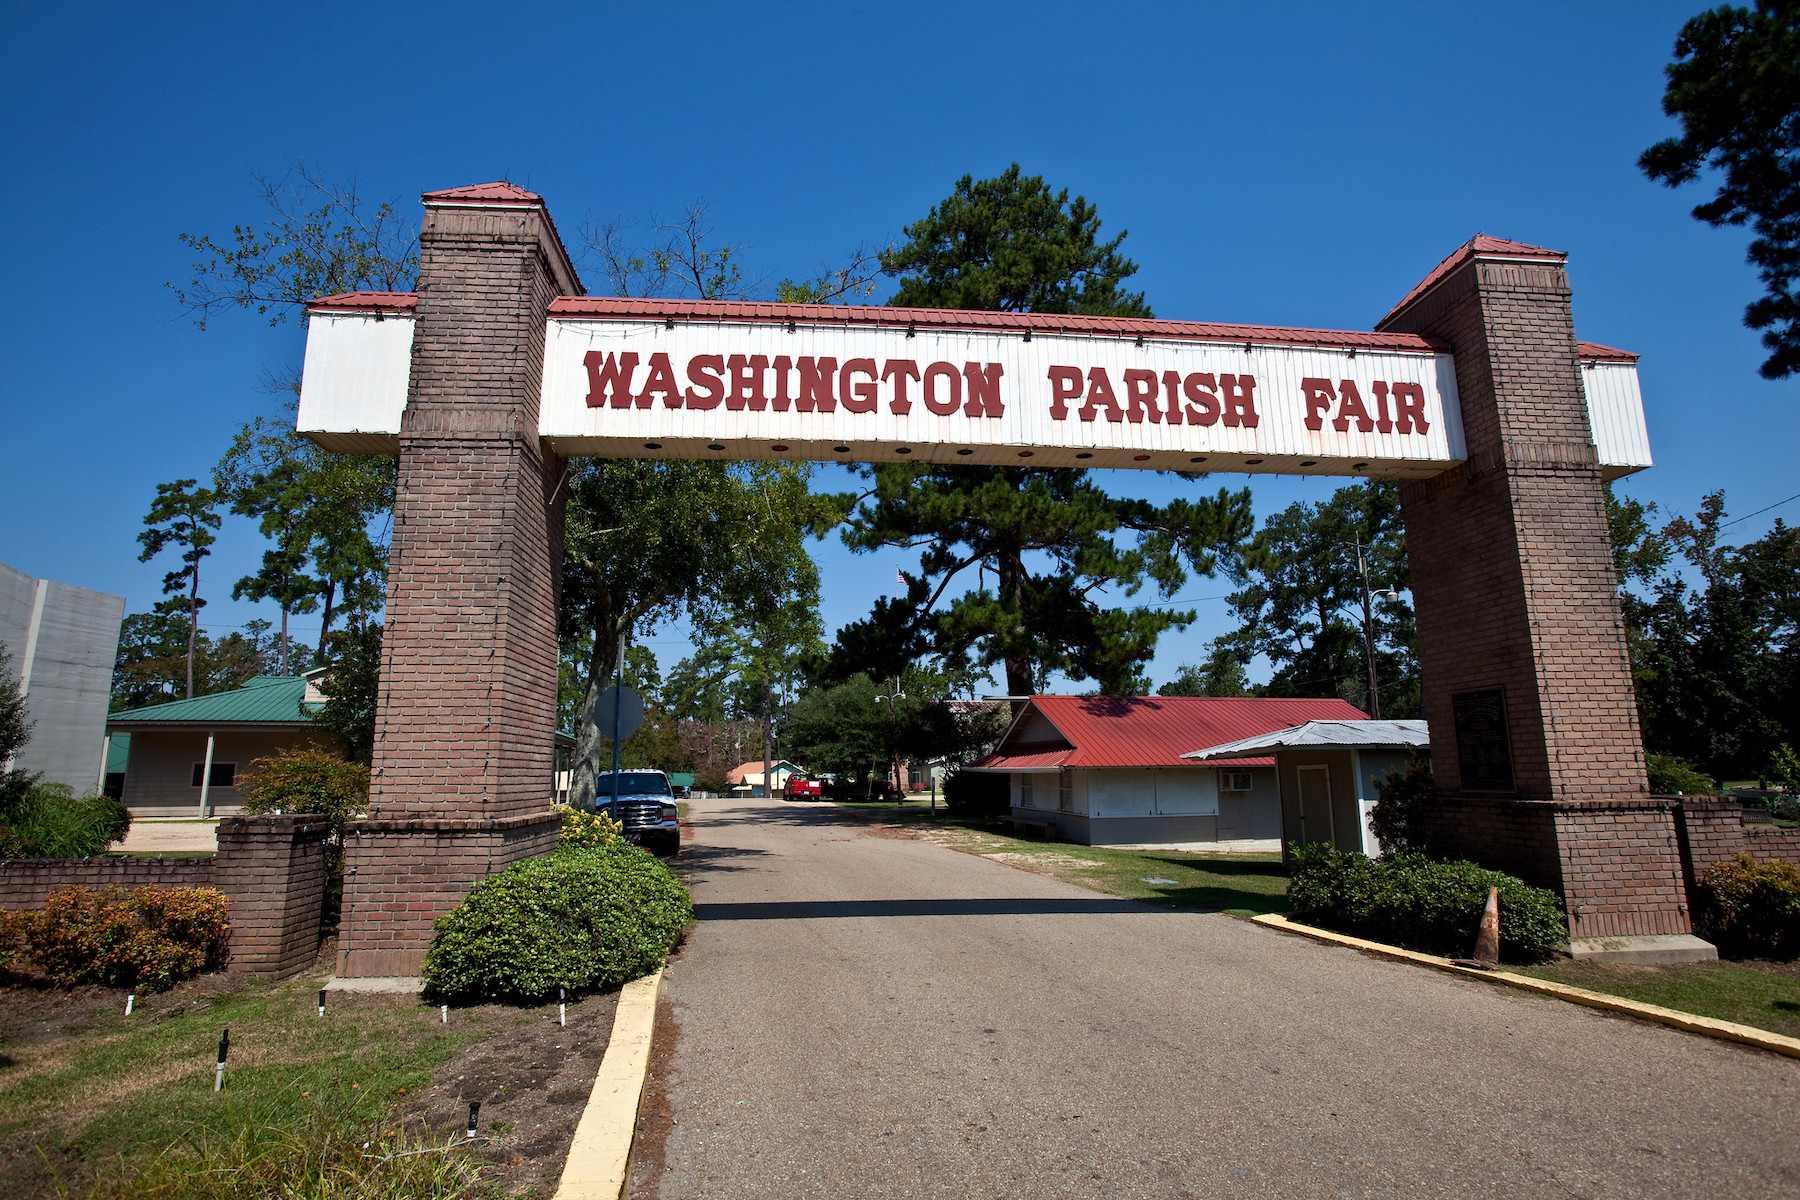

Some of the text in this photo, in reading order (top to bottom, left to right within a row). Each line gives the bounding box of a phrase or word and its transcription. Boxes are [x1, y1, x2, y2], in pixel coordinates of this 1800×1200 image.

[584, 351, 1430, 435] WASHINGTON PARISH FAIR
